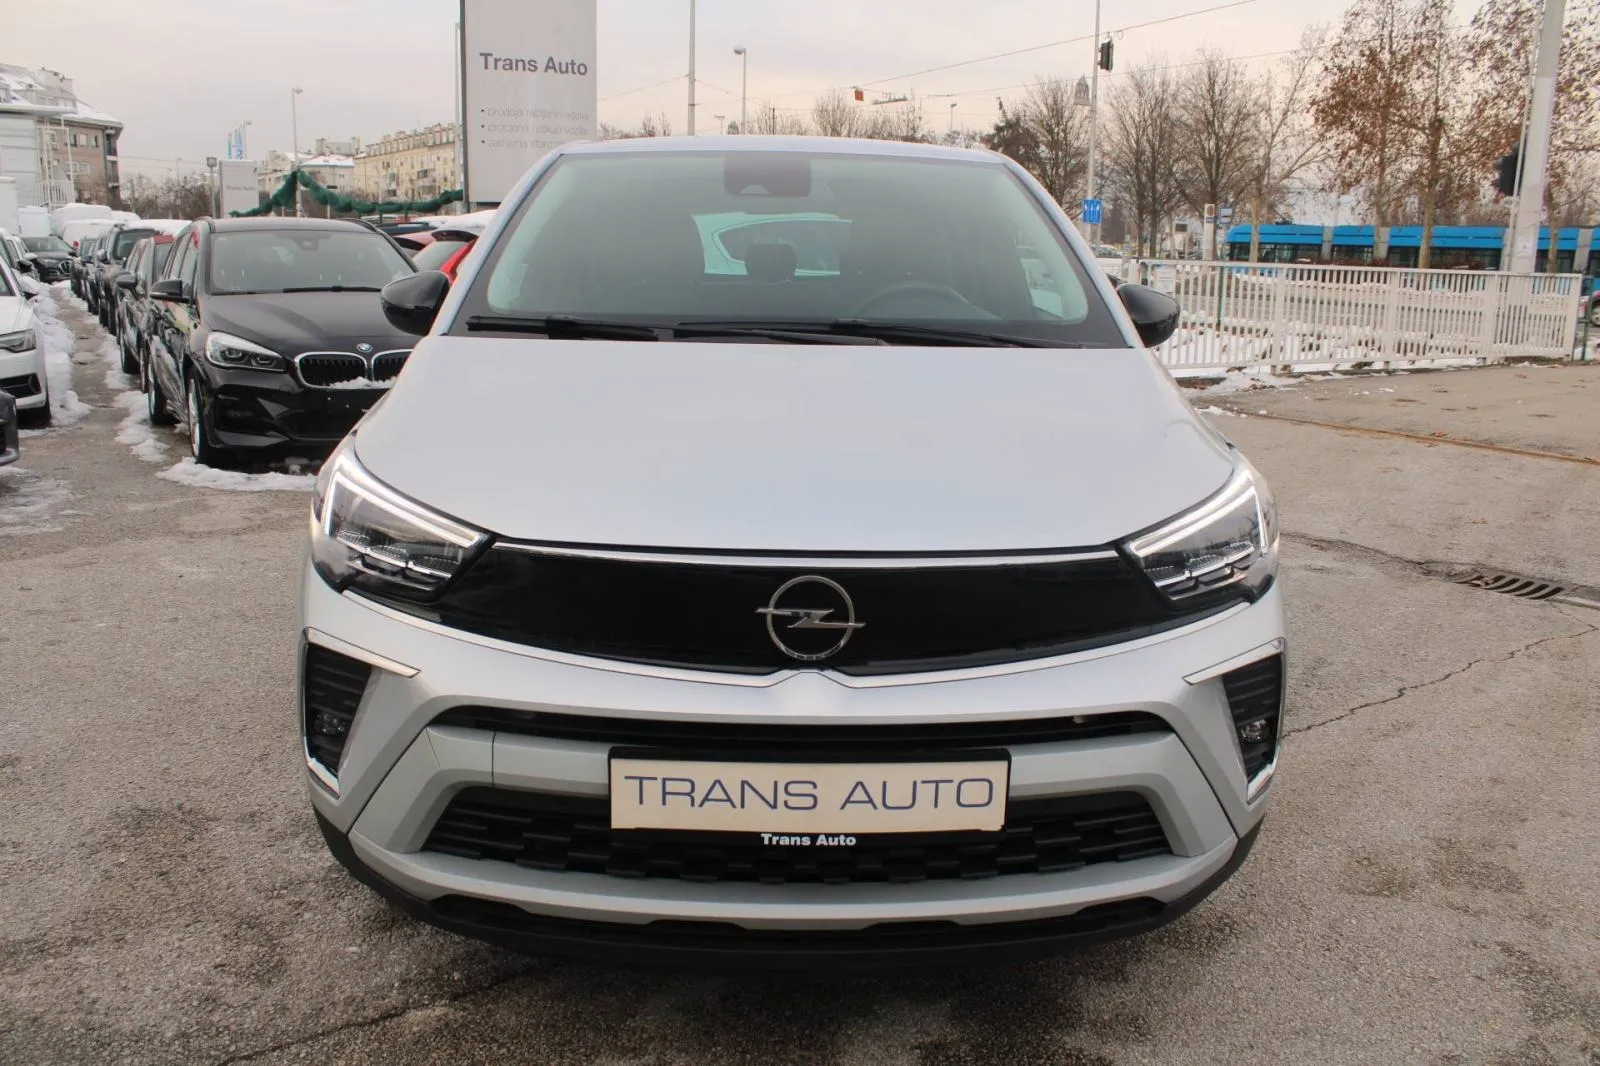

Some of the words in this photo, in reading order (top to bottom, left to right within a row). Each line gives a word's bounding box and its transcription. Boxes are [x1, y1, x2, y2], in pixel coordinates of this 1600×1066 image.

[479, 52, 538, 72] Trans
[543, 57, 588, 76] Auto
[624, 776, 818, 810] TRANS
[840, 778, 994, 810] AUTO
[761, 832, 811, 846] Trans
[816, 833, 857, 847] Auto
